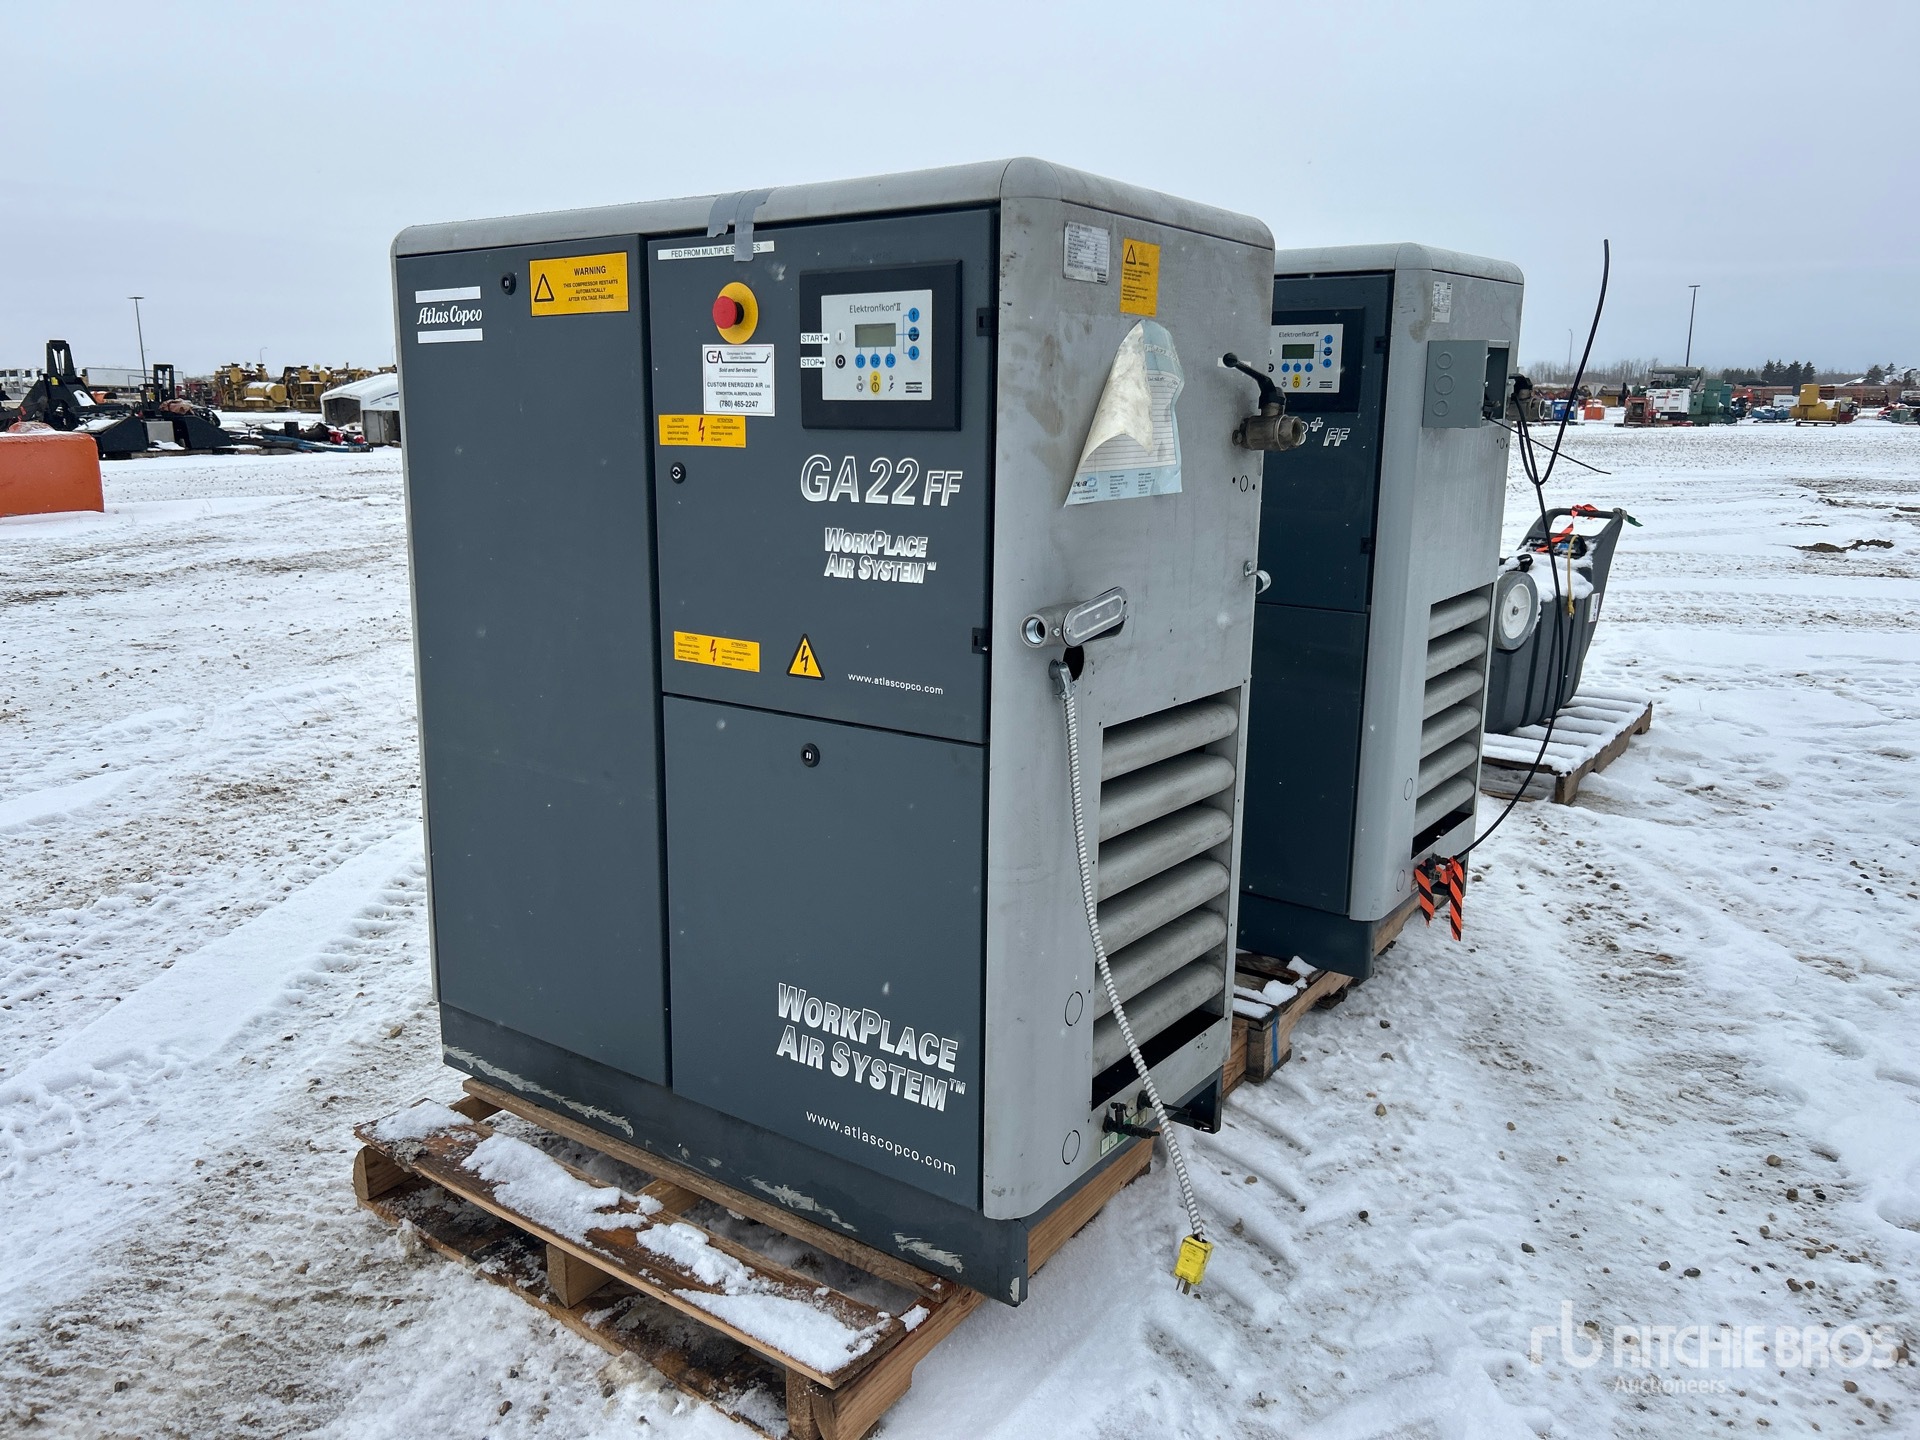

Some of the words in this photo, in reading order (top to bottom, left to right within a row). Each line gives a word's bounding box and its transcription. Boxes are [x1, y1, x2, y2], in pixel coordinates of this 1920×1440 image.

[671, 250, 682, 258] FED
[683, 249, 700, 257] FROM
[701, 246, 729, 256] MULTIPLE
[574, 265, 606, 276] WARNING
[572, 280, 598, 288] COMPRESSOR
[801, 334, 823, 342] START
[857, 357, 864, 365] F1
[871, 357, 879, 365] F2
[719, 400, 733, 409] (780)
[1322, 427, 1351, 447] FF
[922, 470, 963, 507] FF
[847, 673, 944, 695] www.atlascopco.com
[805, 1110, 957, 1176] www.atlascopco.com
